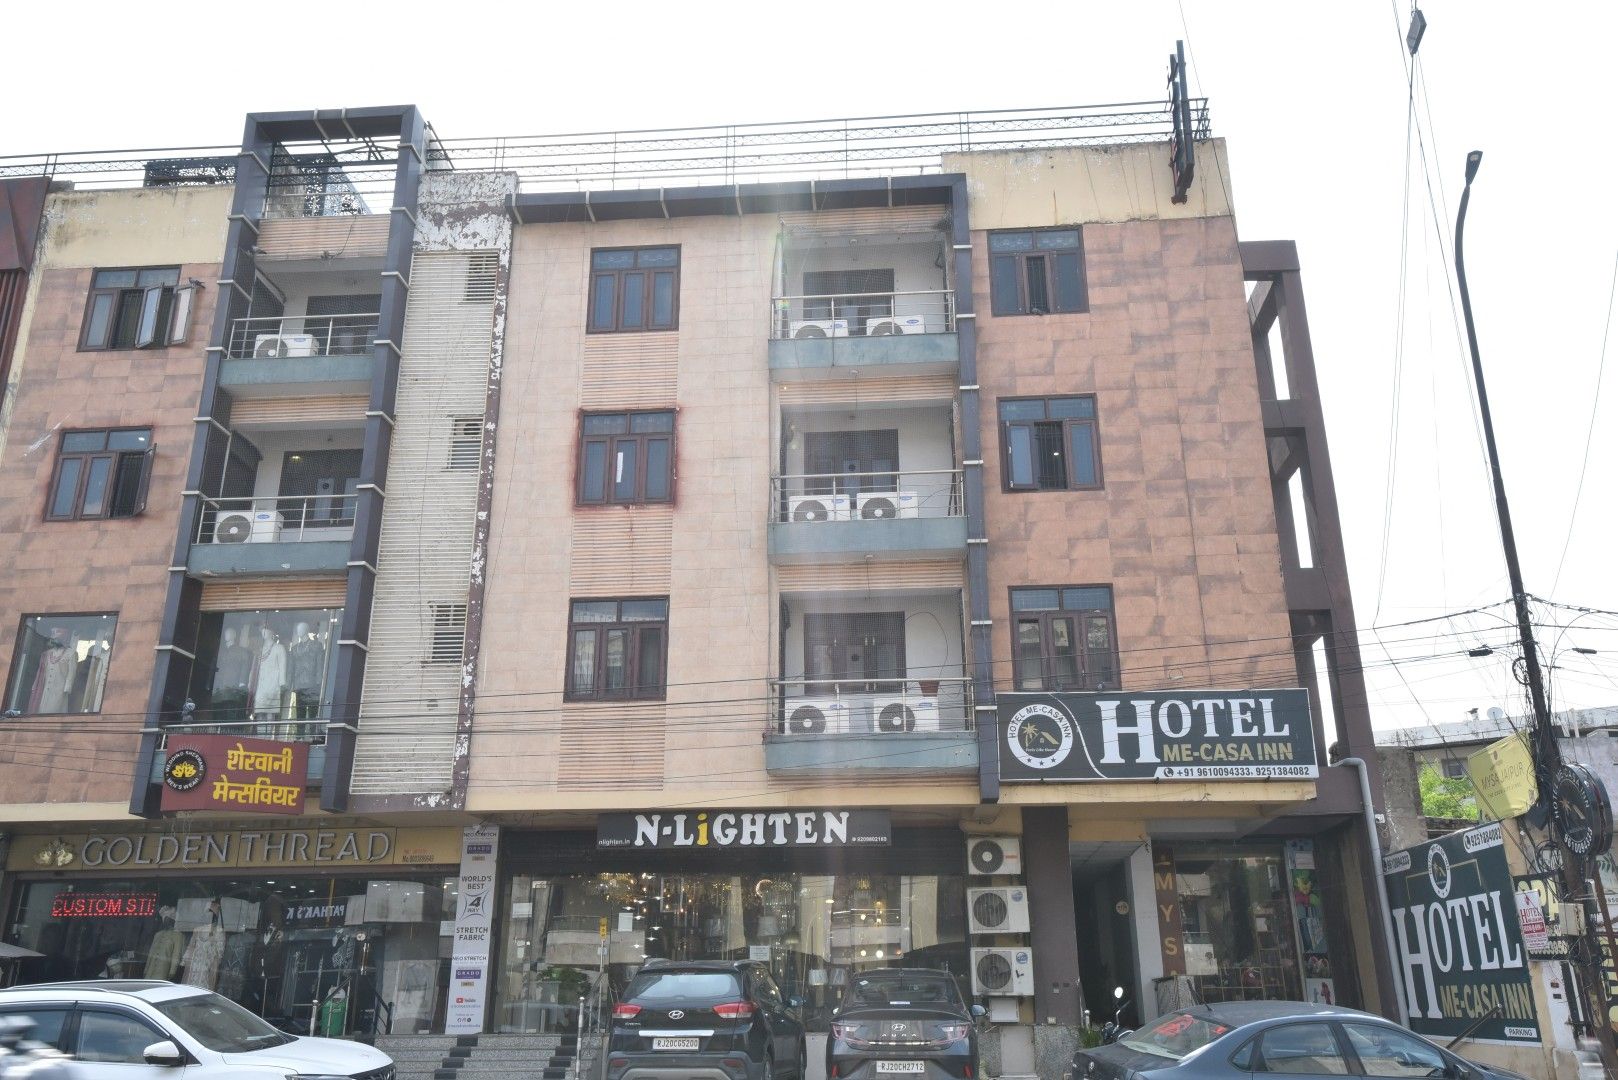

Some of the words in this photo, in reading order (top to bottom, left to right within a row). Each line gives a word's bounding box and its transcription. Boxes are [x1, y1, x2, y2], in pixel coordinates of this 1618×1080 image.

[1008, 712, 1026, 739] HOTEL
[1026, 705, 1064, 723] ME-CASA
[1061, 722, 1072, 739] INN
[1095, 698, 1290, 764] HOTEL
[227, 742, 293, 774] शेरवानी
[1163, 743, 1254, 762] ME-CASA
[1257, 742, 1294, 761] INN
[1177, 768, 1194, 777] +91
[1256, 766, 1310, 777] 9251384082
[212, 774, 301, 807] मेन्सवियर
[81, 832, 232, 867] GOLDEN
[241, 831, 391, 863] THREAD
[461, 875, 492, 883] WORLD'S
[53, 898, 122, 914] CUSTOM
[456, 926, 489, 934] STRETCH
[1392, 890, 1523, 1019] HOTEL
[1440, 983, 1504, 1019] ME-CASA
[1501, 982, 1534, 1020] INN
[657, 1039, 698, 1048] RJ20CG5200
[1508, 1027, 1533, 1037] PARKING
